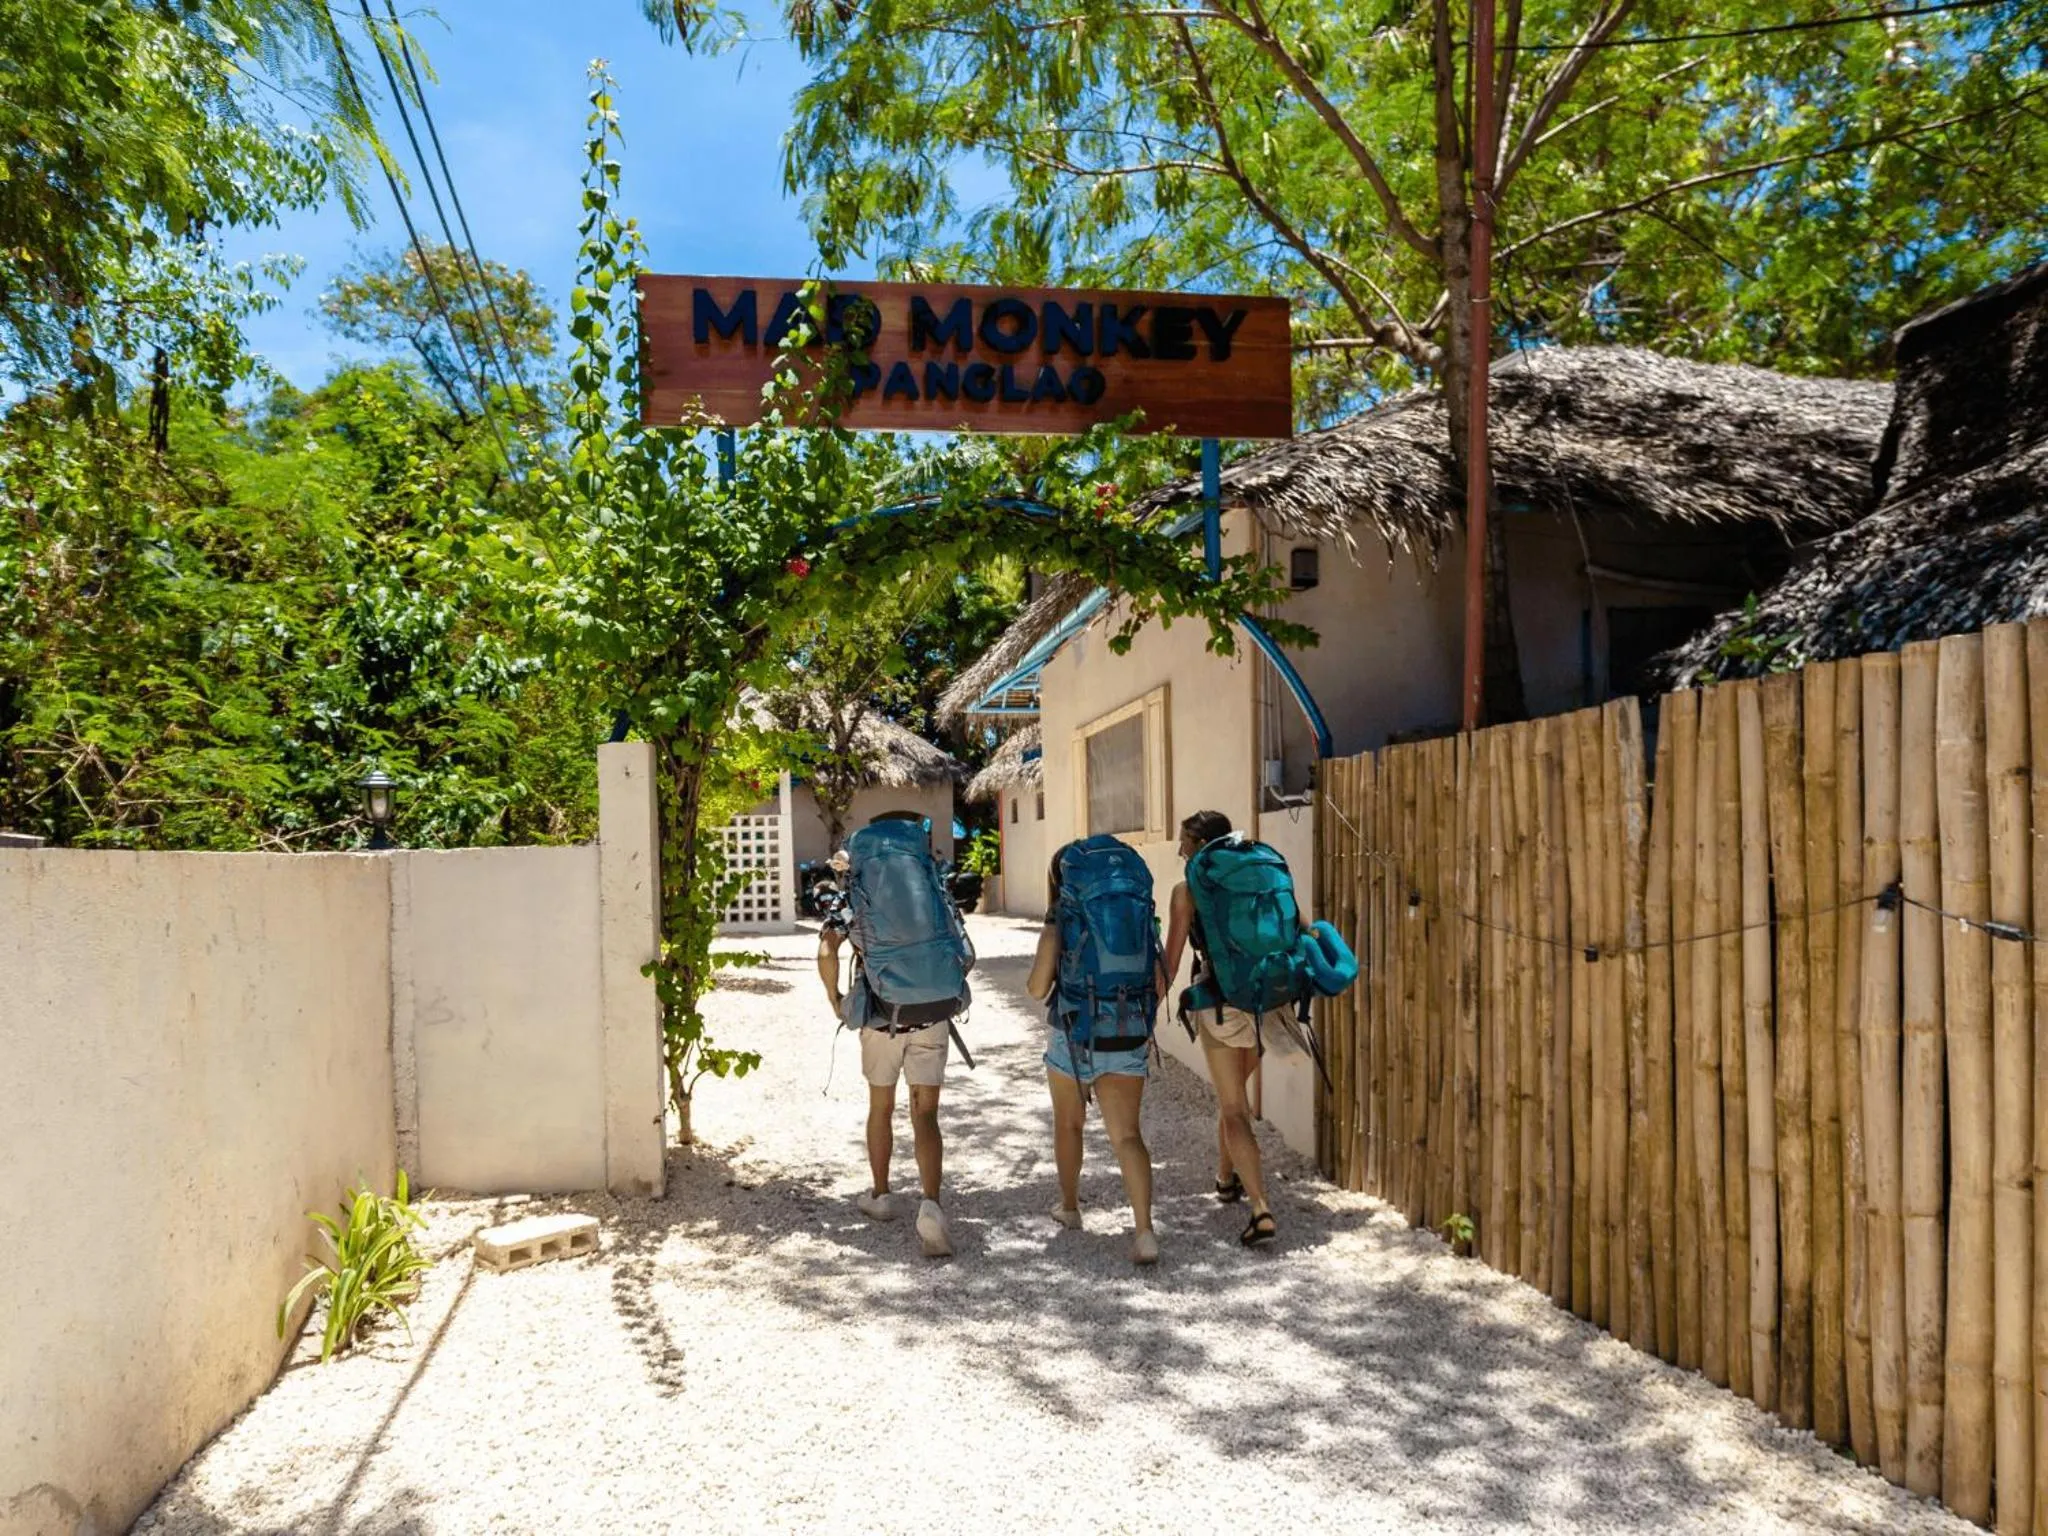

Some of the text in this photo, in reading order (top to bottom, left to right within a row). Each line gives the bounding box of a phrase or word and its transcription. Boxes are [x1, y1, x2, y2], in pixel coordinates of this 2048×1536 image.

[692, 288, 1248, 362] MAD MONKEY
[850, 360, 1106, 406] PANGLAO
